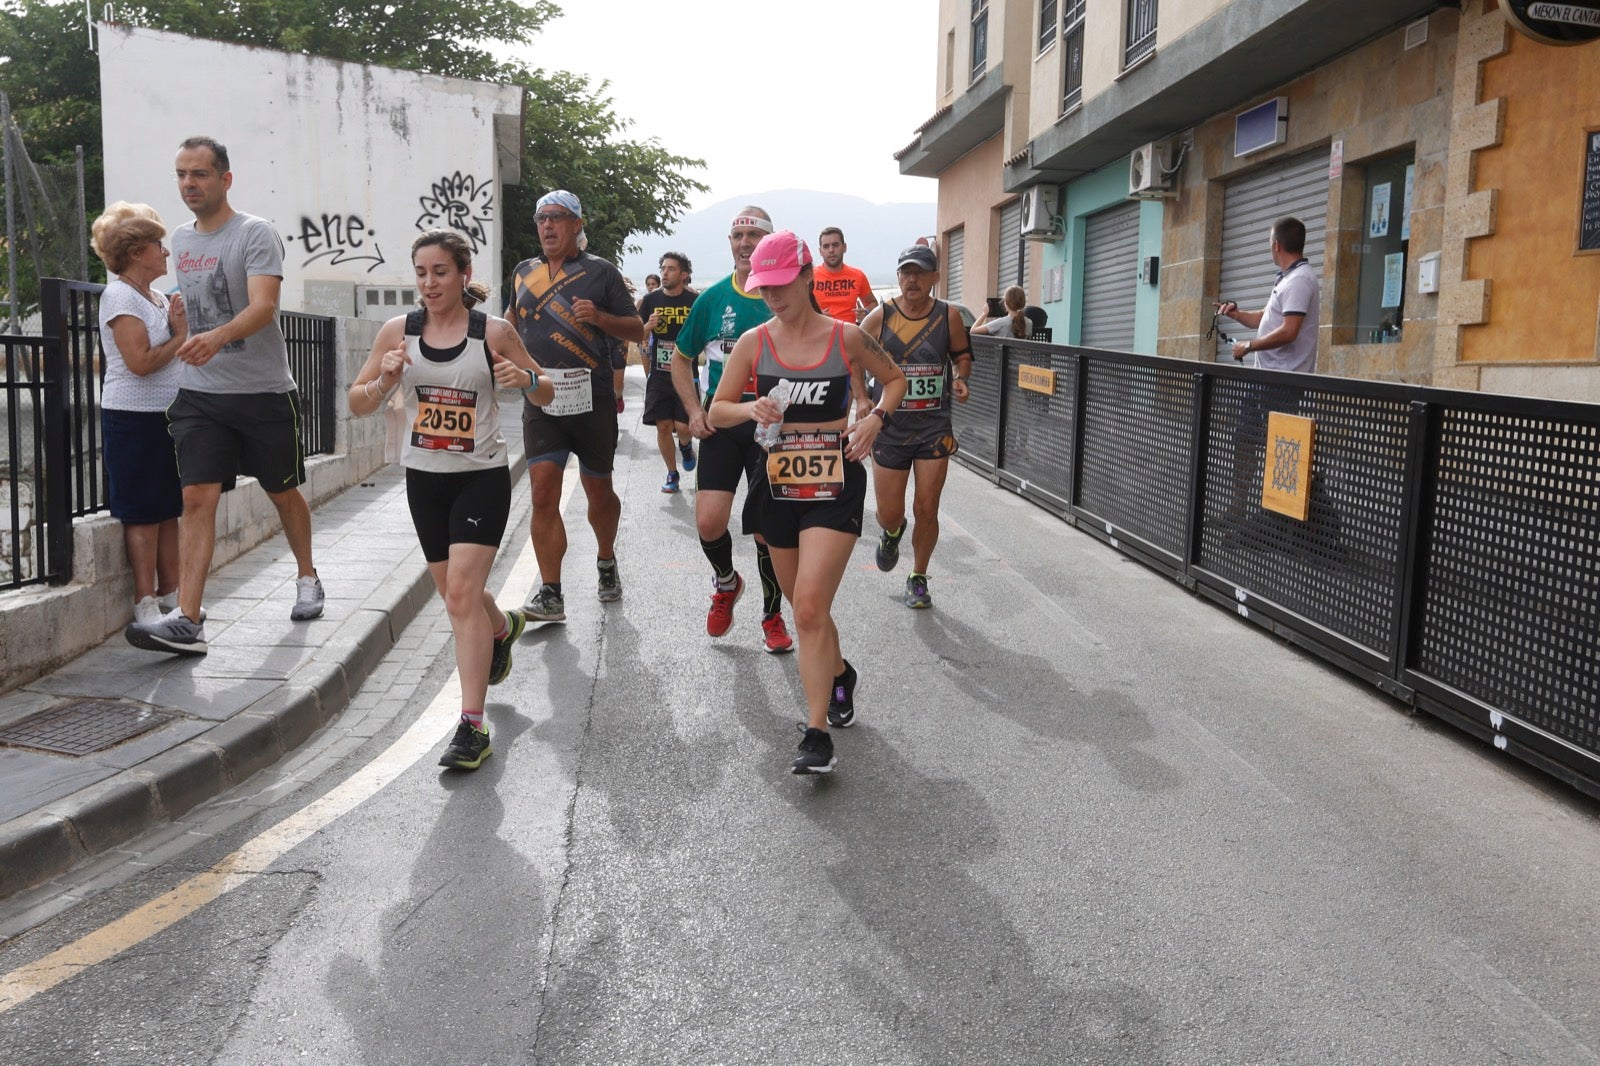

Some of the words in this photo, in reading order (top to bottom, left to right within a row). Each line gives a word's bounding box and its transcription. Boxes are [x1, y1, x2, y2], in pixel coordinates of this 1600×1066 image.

[1532, 4, 1560, 19] MESON
[1562, 8, 1571, 20] EL
[176, 251, 218, 273] London
[816, 279, 856, 291] BREAK
[550, 301, 593, 341] GRANADA
[549, 331, 598, 369] RUNNING
[907, 378, 937, 396] 135
[420, 408, 472, 432] 2050
[821, 433, 837, 442] FONDO
[777, 455, 838, 478] 2057
